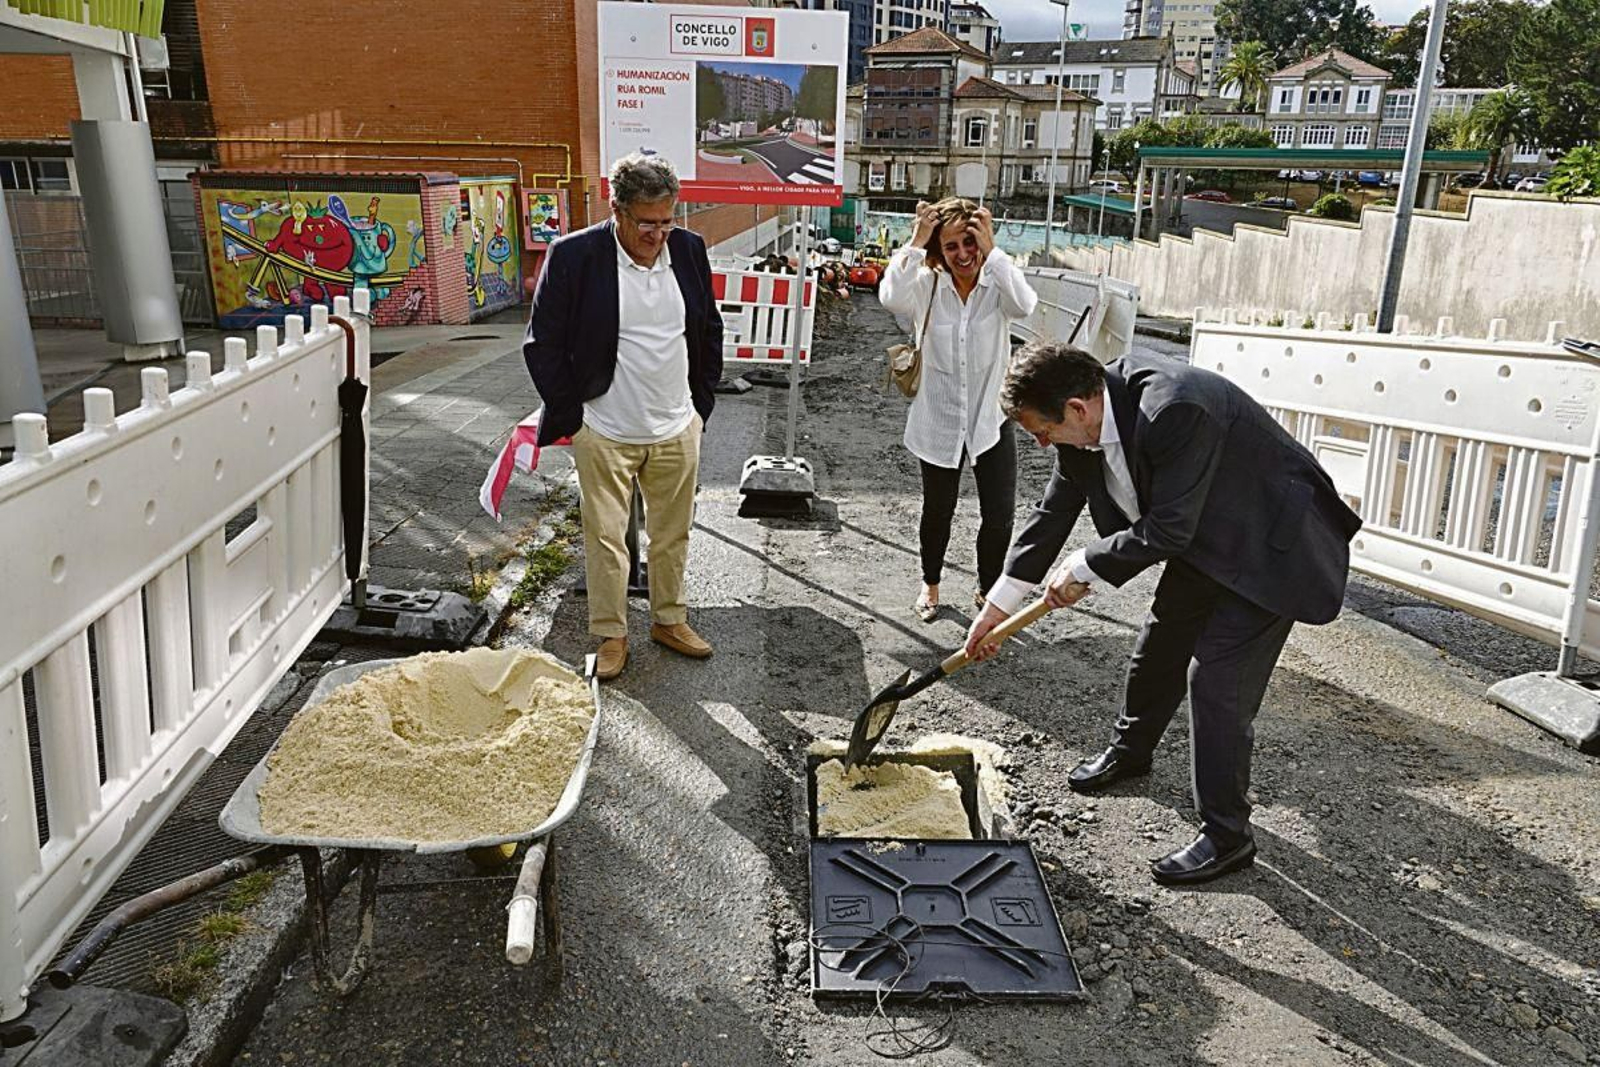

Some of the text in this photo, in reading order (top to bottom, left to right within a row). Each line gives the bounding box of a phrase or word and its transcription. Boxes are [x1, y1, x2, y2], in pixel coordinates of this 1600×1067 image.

[675, 23, 737, 36] CONCELLO
[682, 35, 730, 47] DE VIGO
[616, 69, 690, 81] HUMANIZACIÓN
[638, 84, 666, 95] ROMIL
[617, 99, 638, 109] FASE
